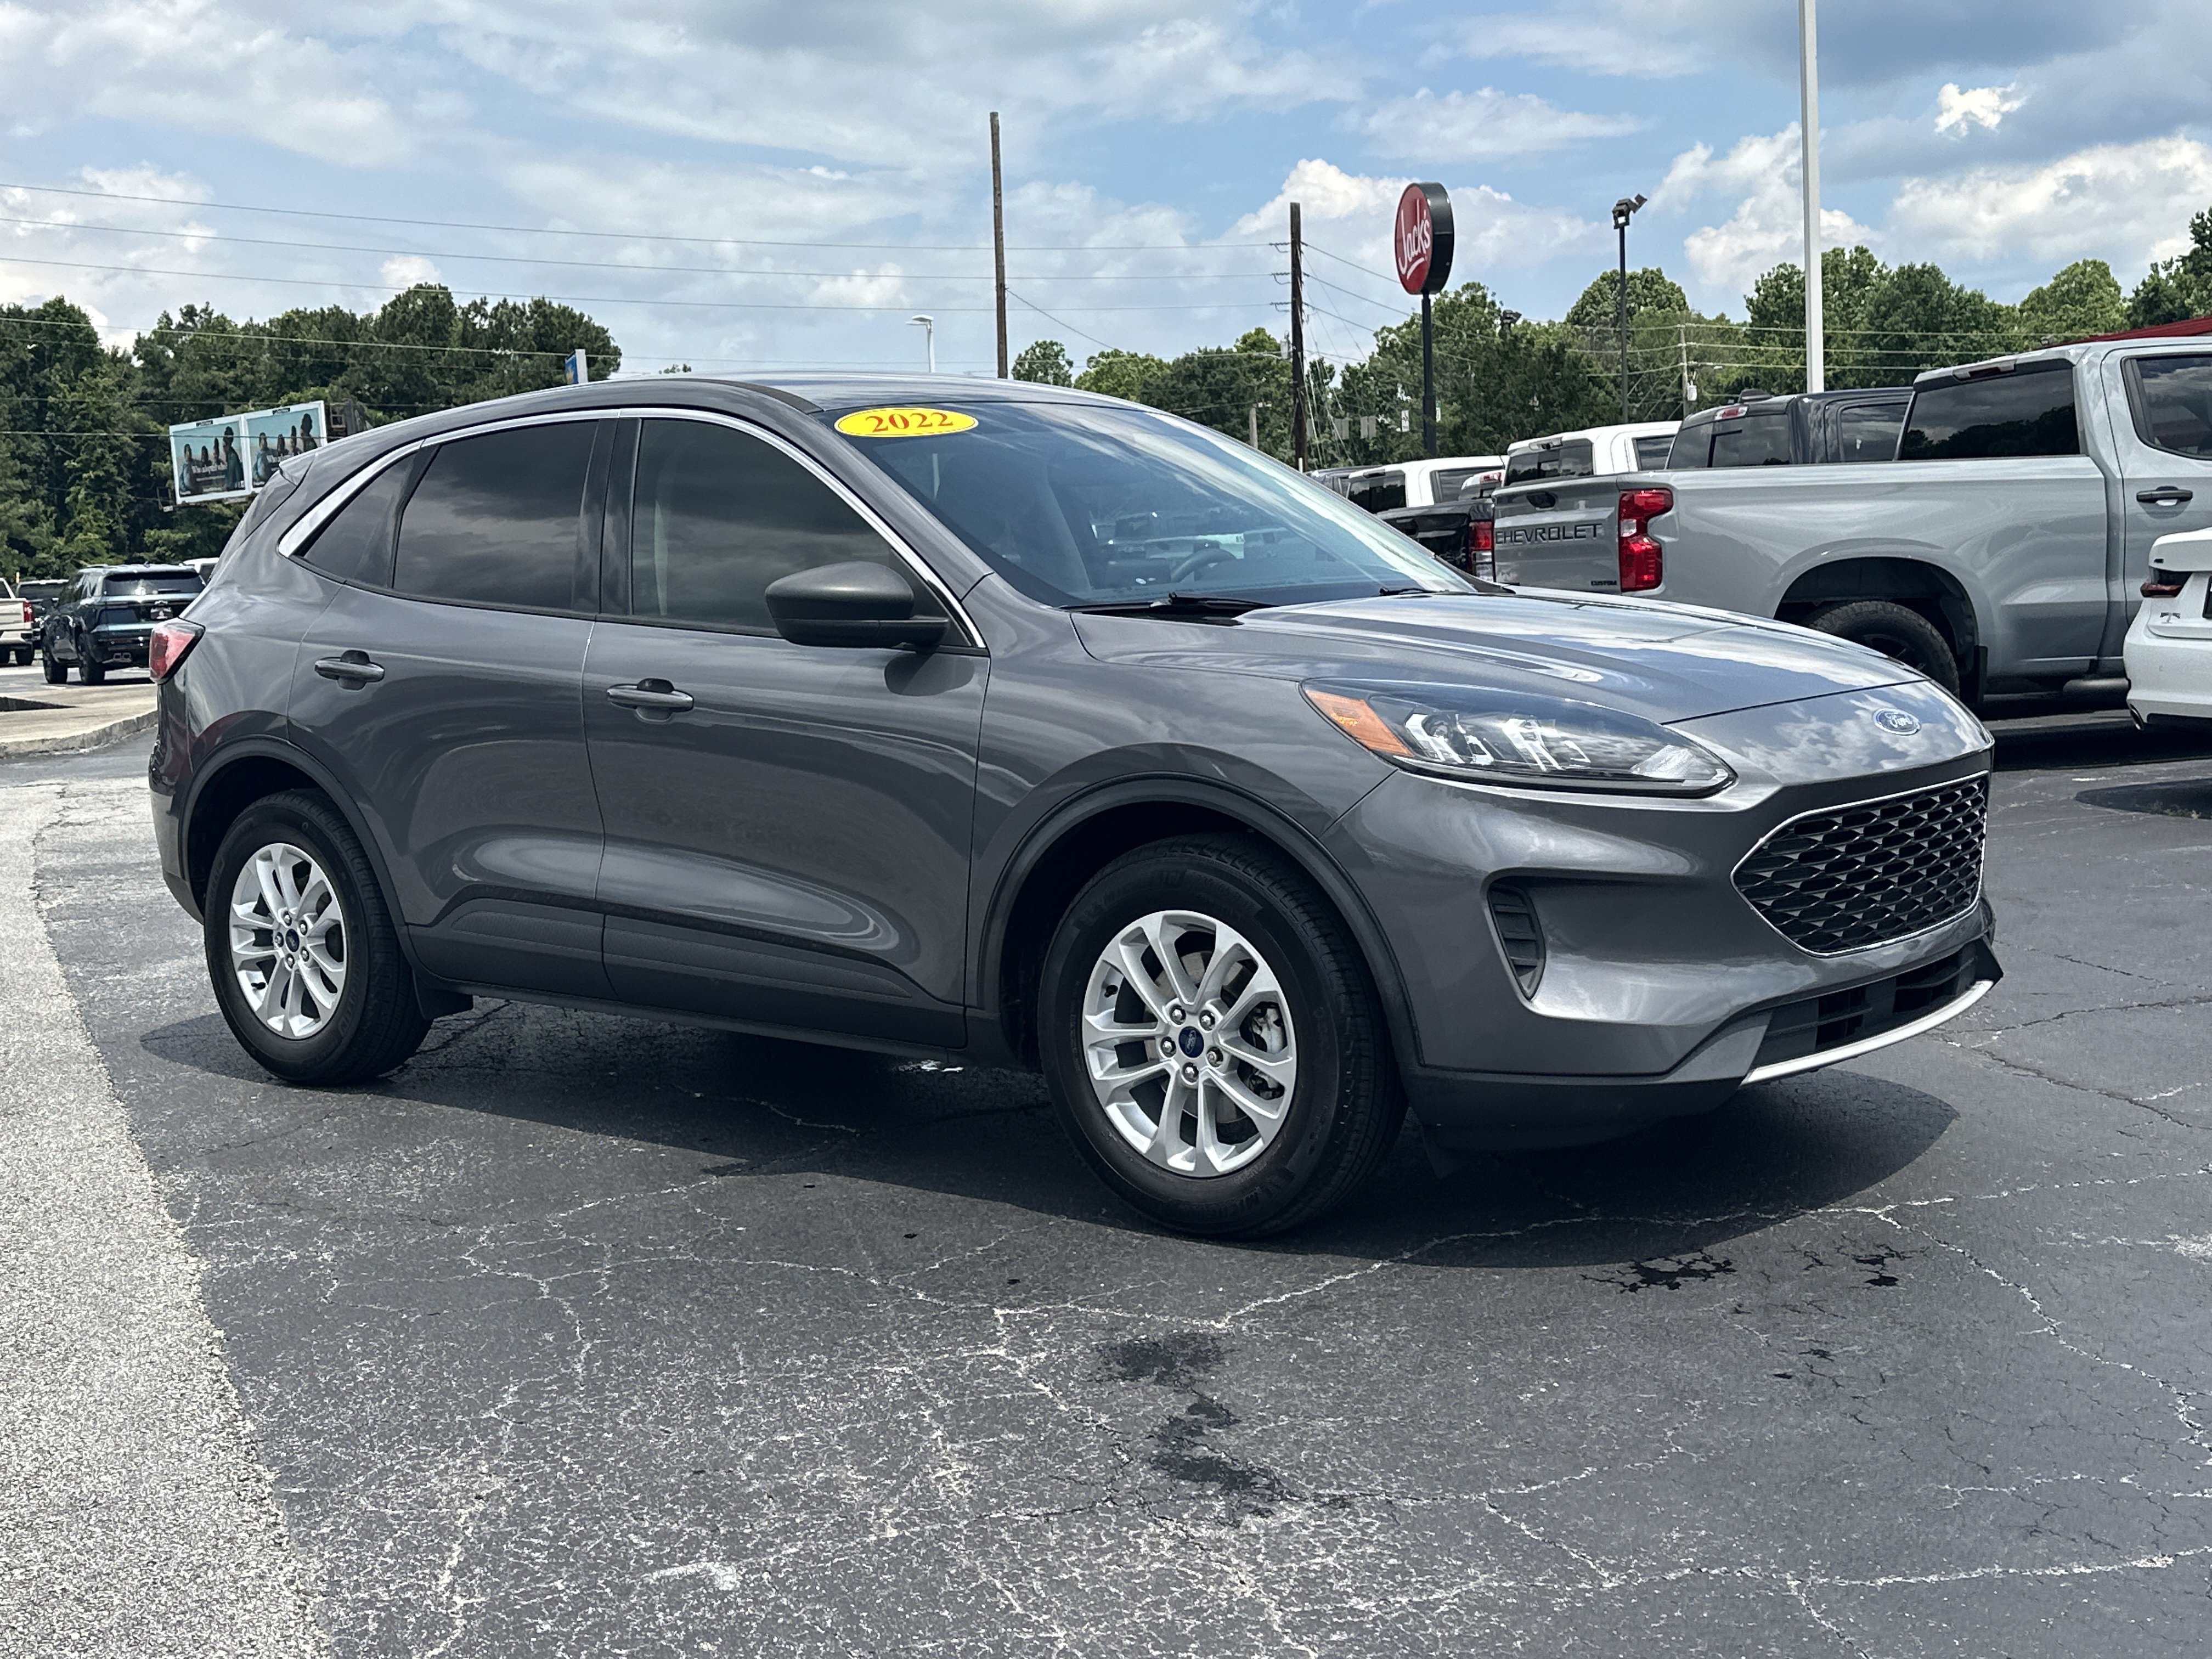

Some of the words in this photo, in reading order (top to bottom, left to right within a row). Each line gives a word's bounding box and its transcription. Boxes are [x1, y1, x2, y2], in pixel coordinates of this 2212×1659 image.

[1398, 198, 1431, 275] Jack's
[865, 412, 953, 432] 2022
[1495, 523, 1602, 544] CHEVROLET
